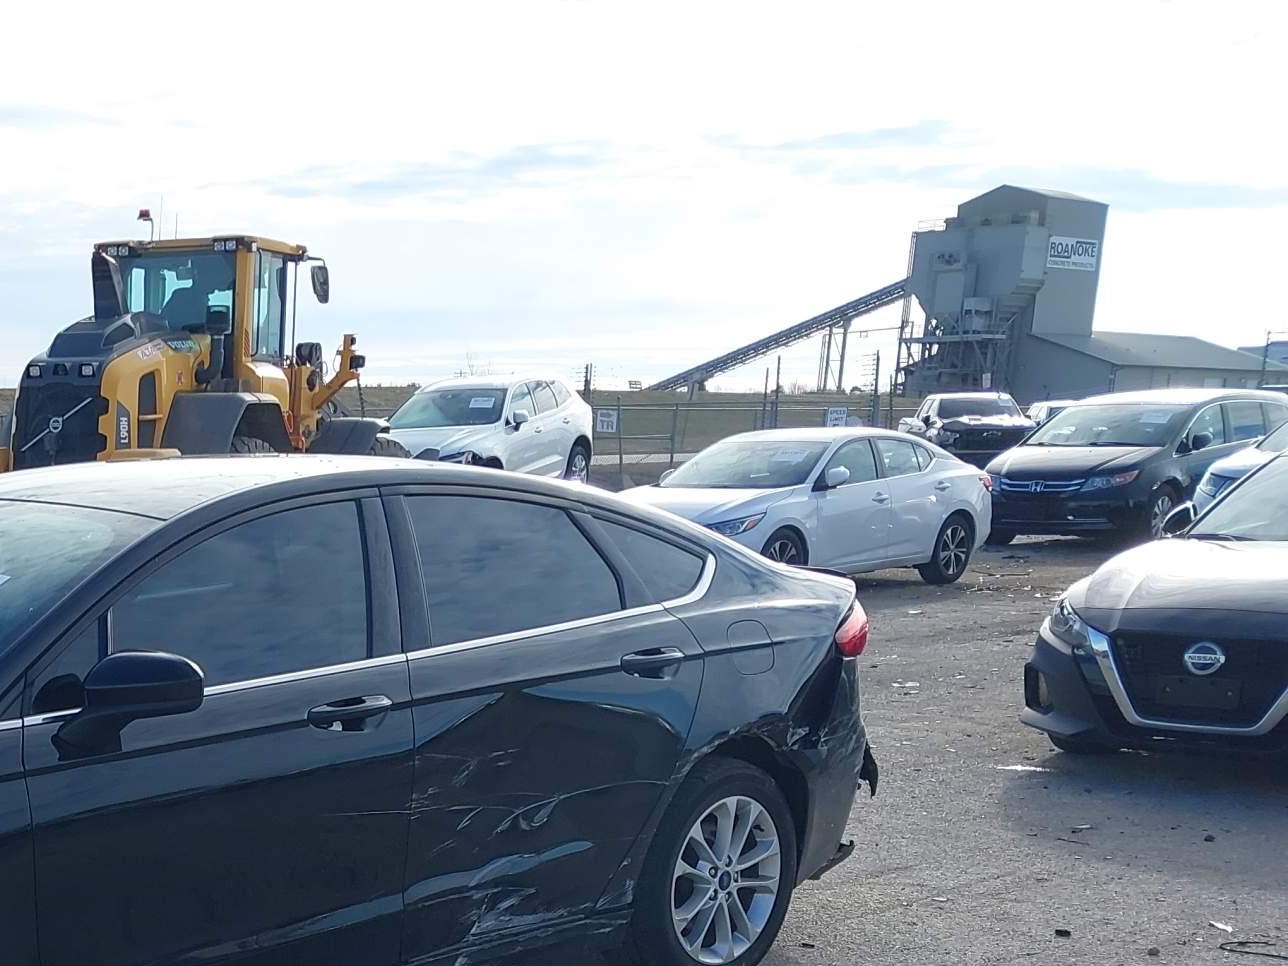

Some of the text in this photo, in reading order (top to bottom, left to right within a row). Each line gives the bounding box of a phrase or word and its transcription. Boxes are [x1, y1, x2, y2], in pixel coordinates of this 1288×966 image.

[1050, 241, 1097, 258] ROANOKE
[119, 417, 129, 444] L90H
[1187, 655, 1221, 663] NISSAN
